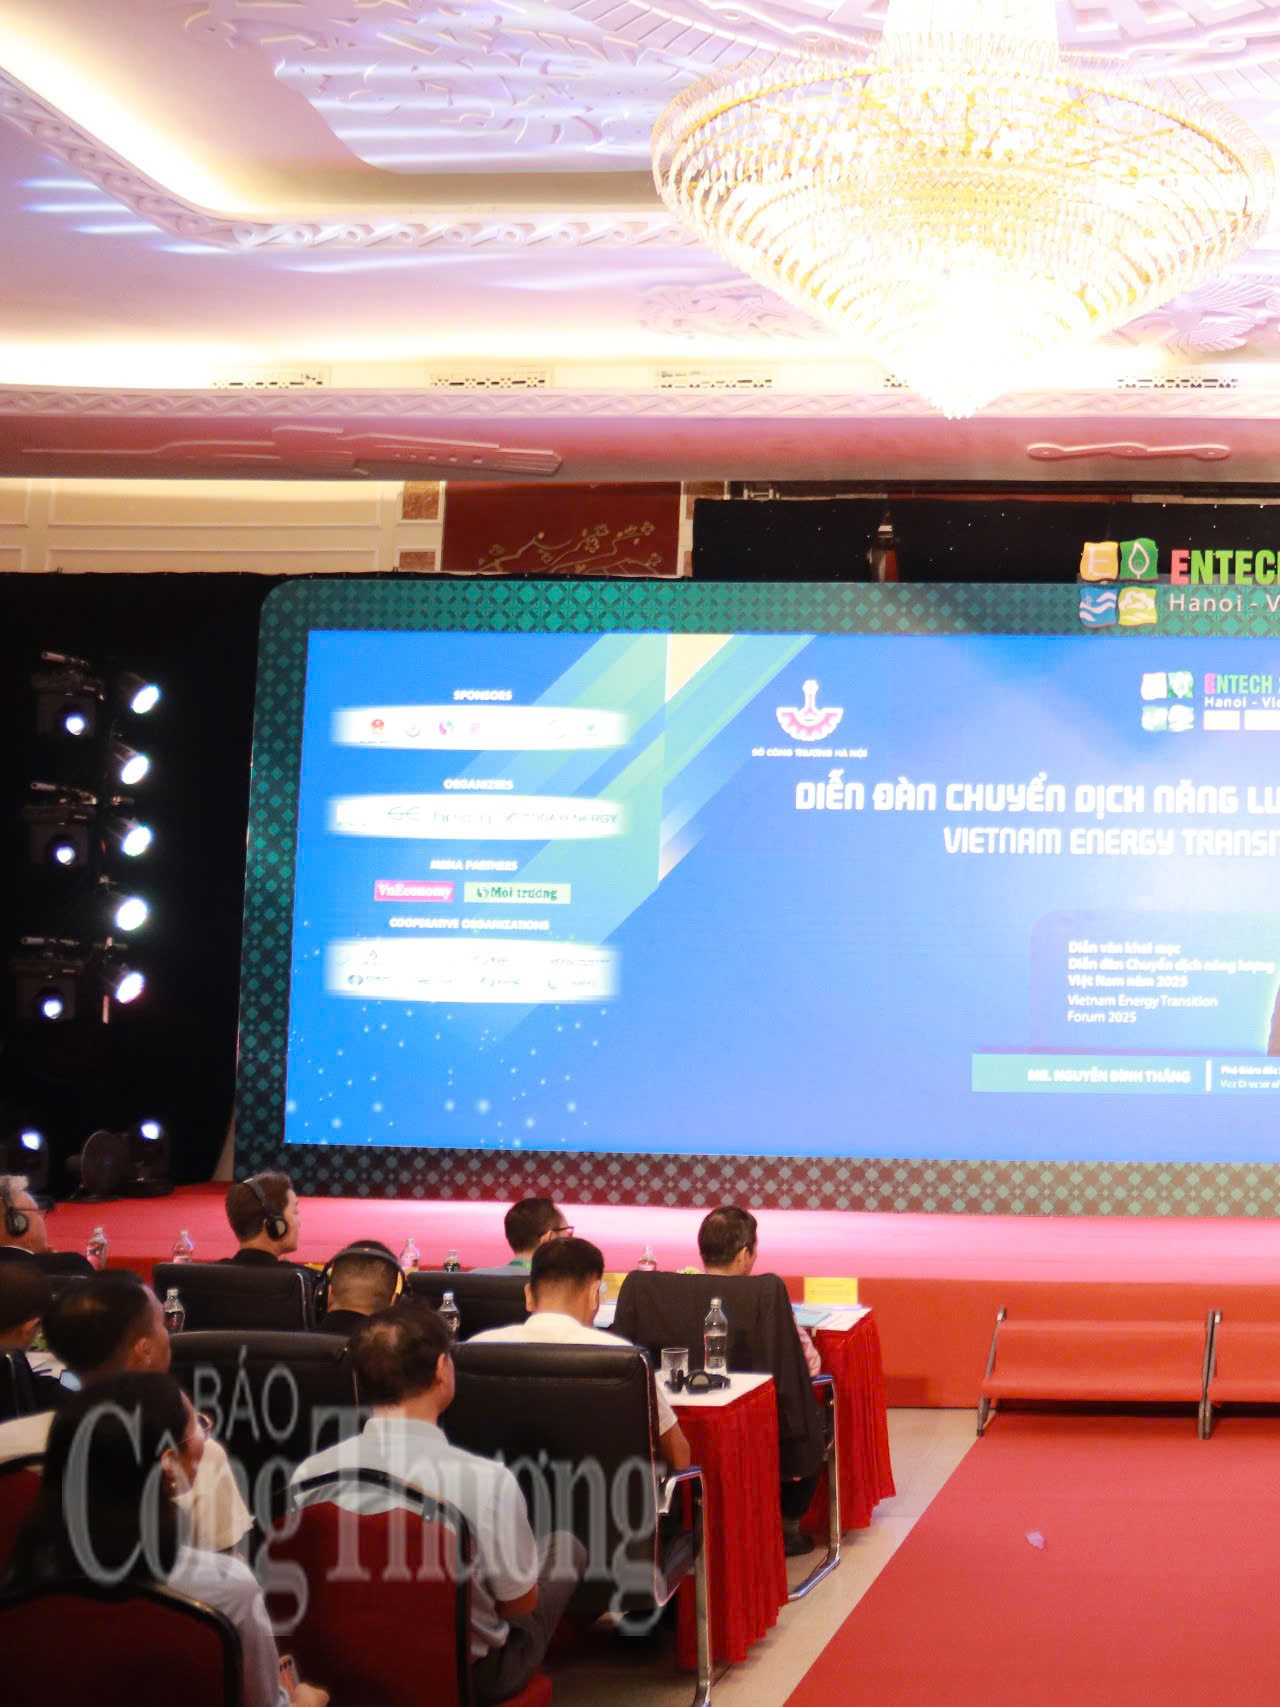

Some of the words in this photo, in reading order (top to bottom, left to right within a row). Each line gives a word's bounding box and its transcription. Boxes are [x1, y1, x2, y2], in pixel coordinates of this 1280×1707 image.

[1169, 593, 1242, 612] Hanoi
[1204, 673, 1272, 694] ENTECH
[1204, 696, 1246, 707] Hanoi
[795, 769, 865, 810] DIỄN
[872, 776, 937, 811] ĐÀN
[945, 772, 1066, 812] CHUYỂN
[1075, 784, 1145, 820] DỊCH
[1153, 779, 1239, 814] NĂNG
[943, 827, 1062, 854] VIETNAM
[1070, 828, 1175, 855] ENERGY
[378, 883, 452, 900] VnEconomy
[1156, 975, 1188, 988] 2025
[1067, 994, 1116, 1007] Vietnam
[1118, 994, 1159, 1009] Energy
[1160, 995, 1219, 1008] Transition
[1067, 1011, 1105, 1023] Forum
[1108, 1011, 1137, 1023] 2025
